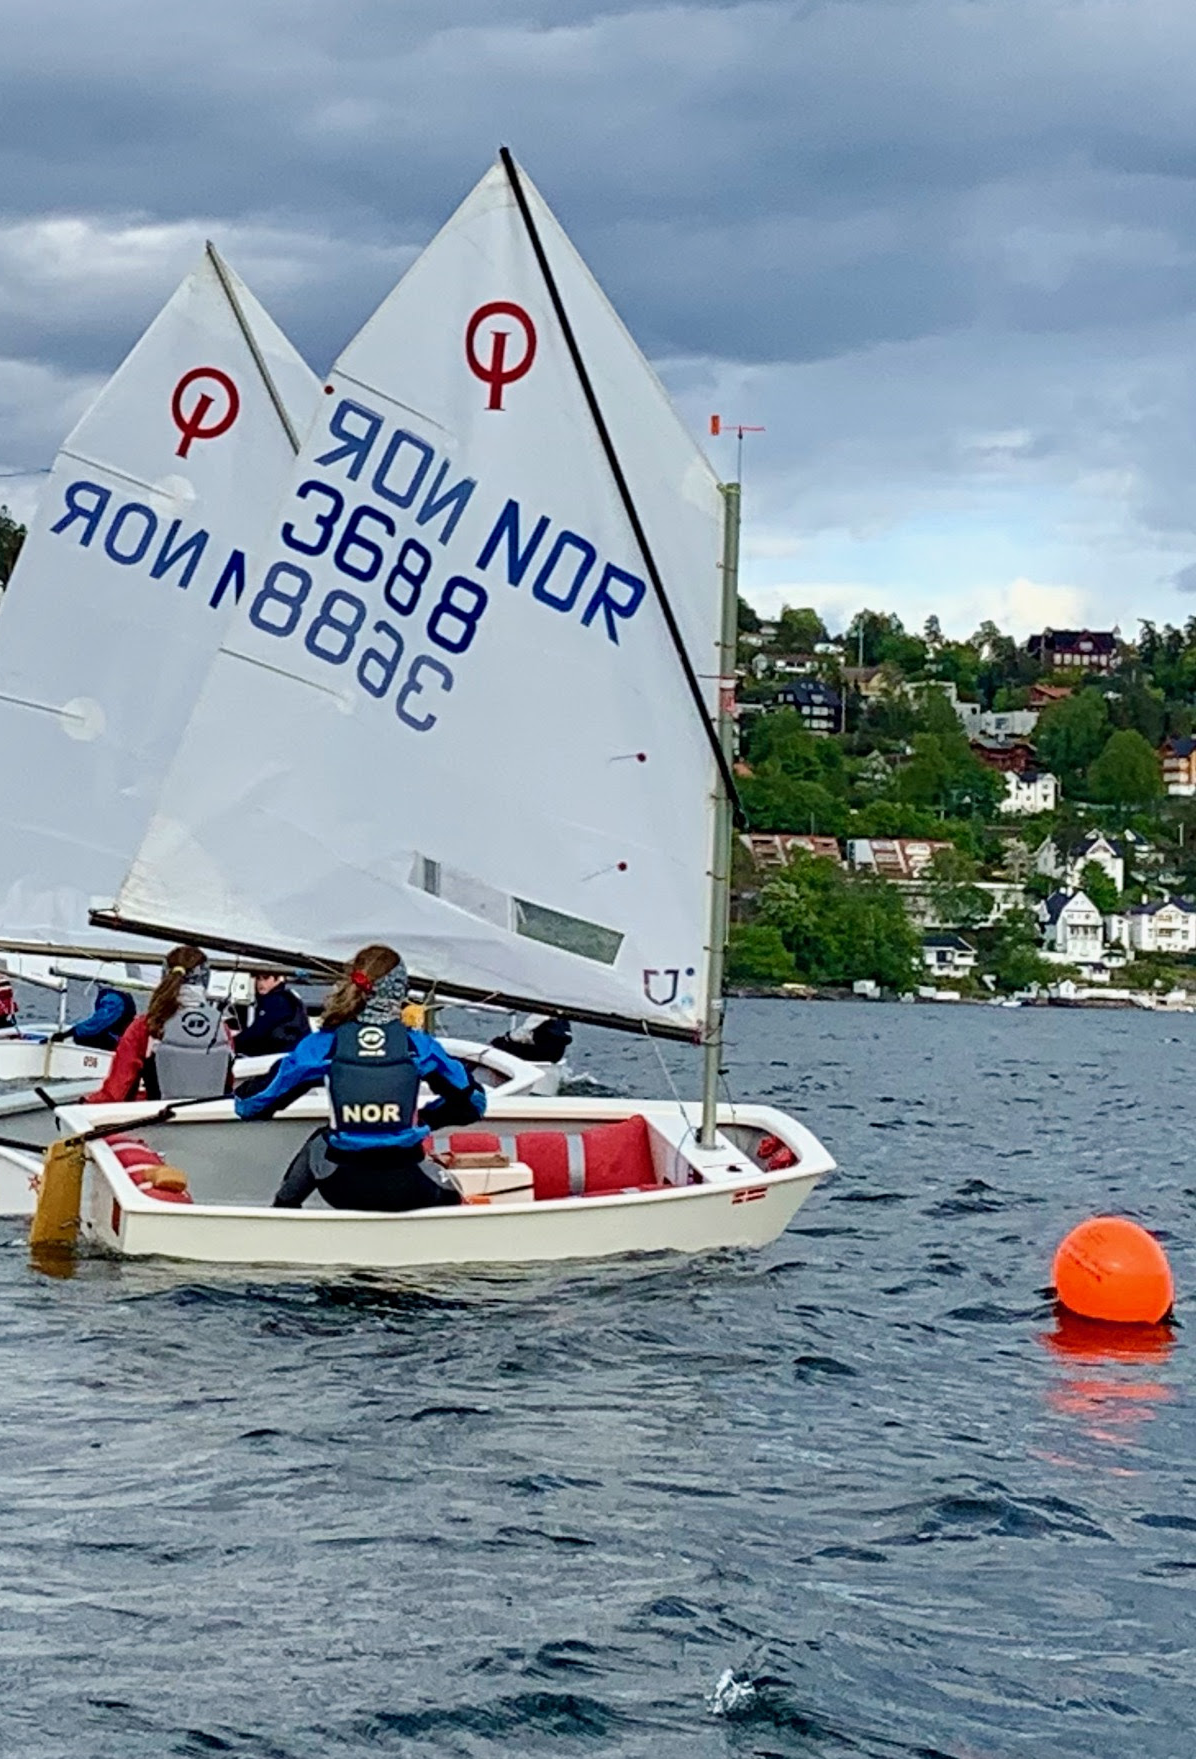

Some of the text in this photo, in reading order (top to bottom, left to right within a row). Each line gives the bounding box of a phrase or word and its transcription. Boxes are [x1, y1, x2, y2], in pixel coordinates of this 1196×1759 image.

[281, 480, 488, 654] 3688
[475, 498, 647, 647] NOR
[342, 1104, 401, 1123] NOR
